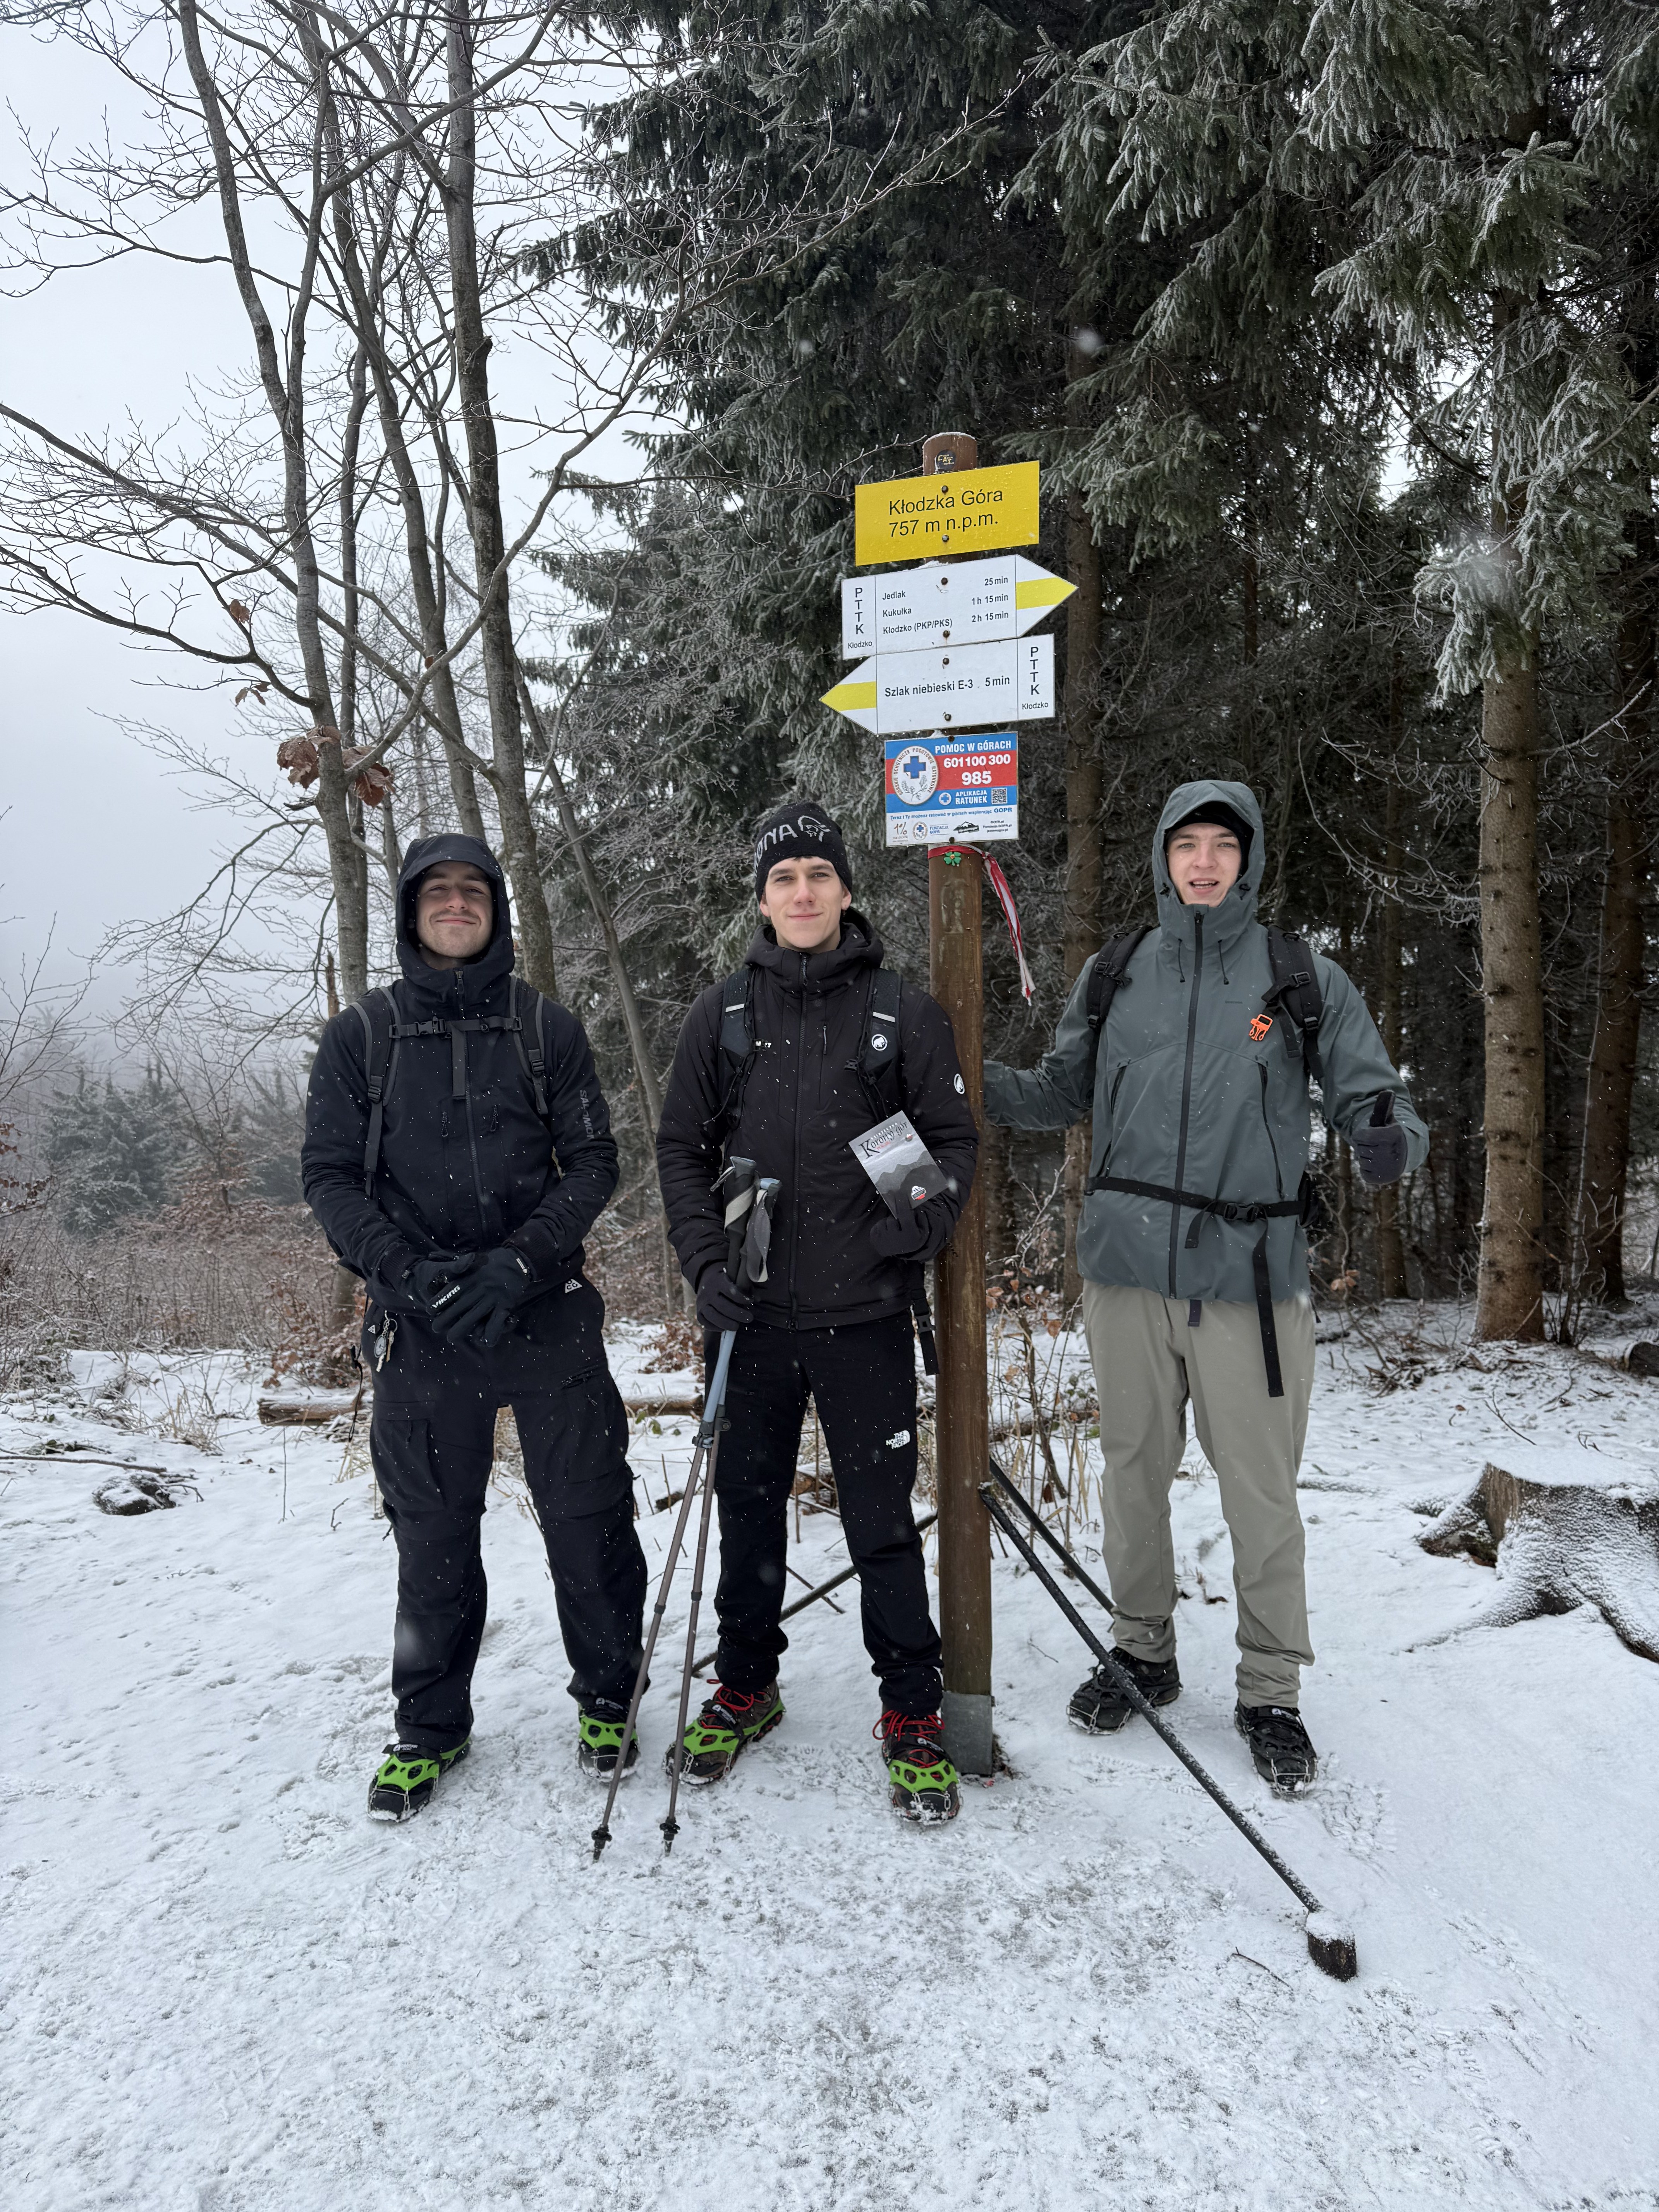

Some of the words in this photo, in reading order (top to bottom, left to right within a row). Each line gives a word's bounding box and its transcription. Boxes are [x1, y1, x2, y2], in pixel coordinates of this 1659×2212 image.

[890, 495, 955, 515] Kłodzka
[962, 489, 1003, 505] Góra
[889, 519, 919, 537] 757
[926, 520, 940, 532] m
[946, 514, 998, 532] n.p.m.
[882, 590, 906, 600] Jedlak
[994, 576, 1008, 584] min
[883, 607, 912, 617] Kukułka
[972, 597, 975, 605] 1
[994, 594, 1008, 602] min
[883, 624, 912, 634] Kłodzko
[914, 618, 952, 632] (PKP/PKS)
[985, 613, 993, 621] 15
[995, 611, 1008, 620] min
[885, 686, 910, 697] Szlak
[913, 681, 955, 694] niebieski
[958, 679, 973, 689] E-3
[985, 677, 990, 687] 5
[992, 675, 1010, 686] min
[935, 744, 965, 754] POMOC
[967, 743, 975, 751] W
[977, 740, 1012, 751] GÓRACH
[943, 757, 963, 768] 601
[965, 756, 986, 766] 100
[988, 754, 1011, 765] 300
[962, 770, 992, 785] 985
[955, 796, 987, 805] RATUNEK
[894, 822, 907, 835] 1%
[858, 1130, 895, 1159] Korony
[432, 1285, 460, 1308] VIKING
